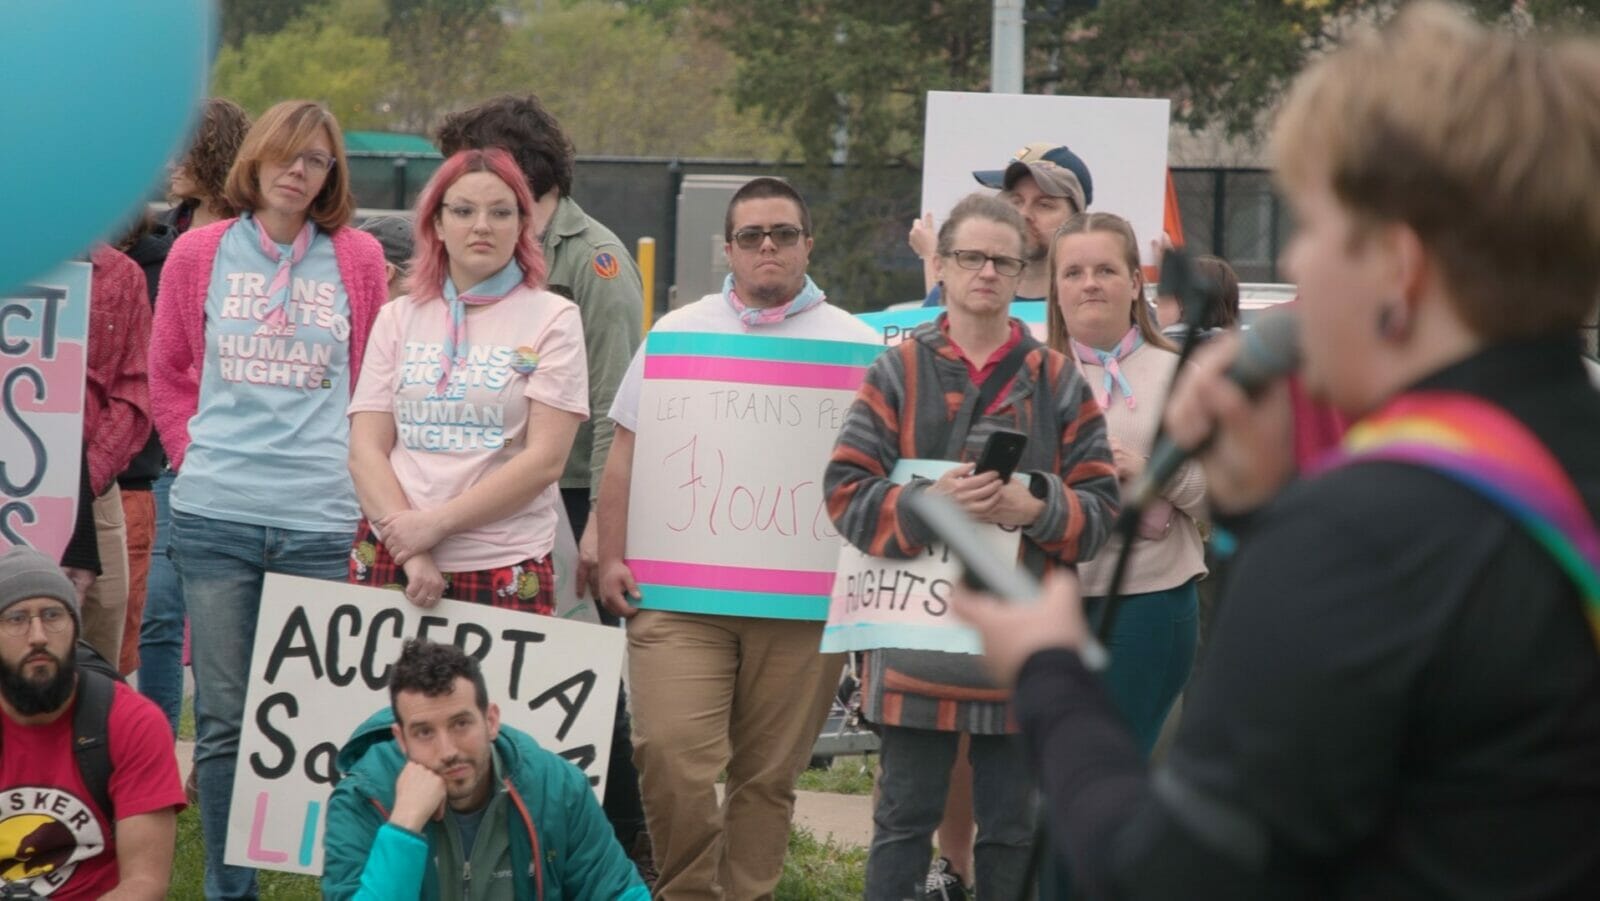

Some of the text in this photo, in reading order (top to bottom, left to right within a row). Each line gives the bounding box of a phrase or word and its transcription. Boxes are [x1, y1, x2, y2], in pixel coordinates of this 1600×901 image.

[225, 272, 337, 307] TRNS
[219, 335, 333, 368] HUMAN
[405, 341, 513, 368] TRNS
[221, 359, 326, 389] RIGHTS
[398, 400, 504, 427] HUMAN
[656, 396, 691, 422] LET
[709, 390, 802, 427] TRANS
[399, 423, 505, 450] RIGHTS
[0, 791, 91, 832] SKER
